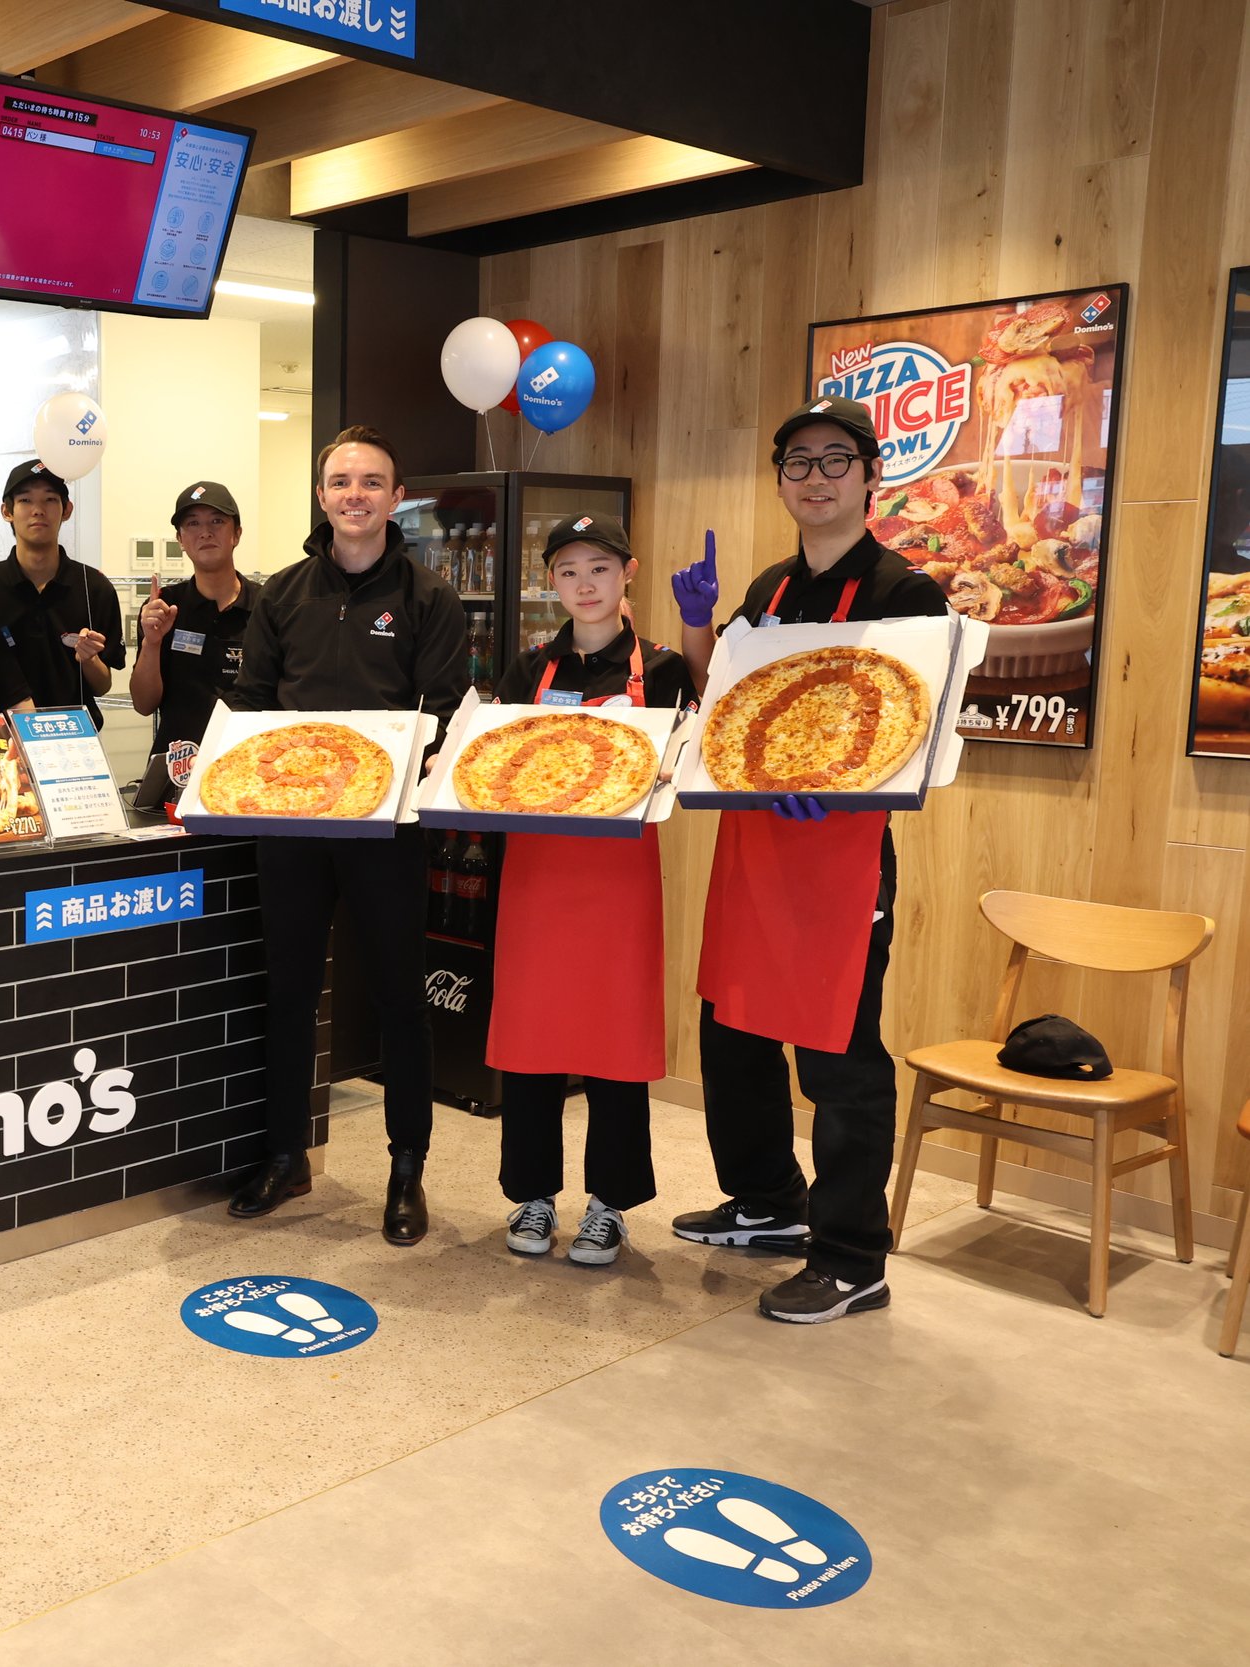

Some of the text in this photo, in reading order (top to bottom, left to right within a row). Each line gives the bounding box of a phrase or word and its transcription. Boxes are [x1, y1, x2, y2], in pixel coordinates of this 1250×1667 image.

[2, 126, 23, 138] 0415
[139, 128, 161, 140] 10:53
[1074, 322, 1114, 334] Domino's
[831, 343, 871, 374] New
[523, 393, 564, 407] Domino's
[862, 369, 966, 440] ICE
[880, 431, 932, 462] OWL
[885, 454, 925, 470] ライスボウル
[169, 746, 193, 763] PIZZA
[173, 754, 197, 777] RIC
[61, 886, 173, 927] 商品お渡し
[195, 1281, 292, 1317] お待ちください
[200, 1280, 256, 1303] こちらで
[298, 1326, 367, 1354] Please wait here
[617, 1475, 684, 1512] こちらで
[620, 1478, 725, 1537] お待ちください
[786, 1555, 859, 1602] Please wait here
